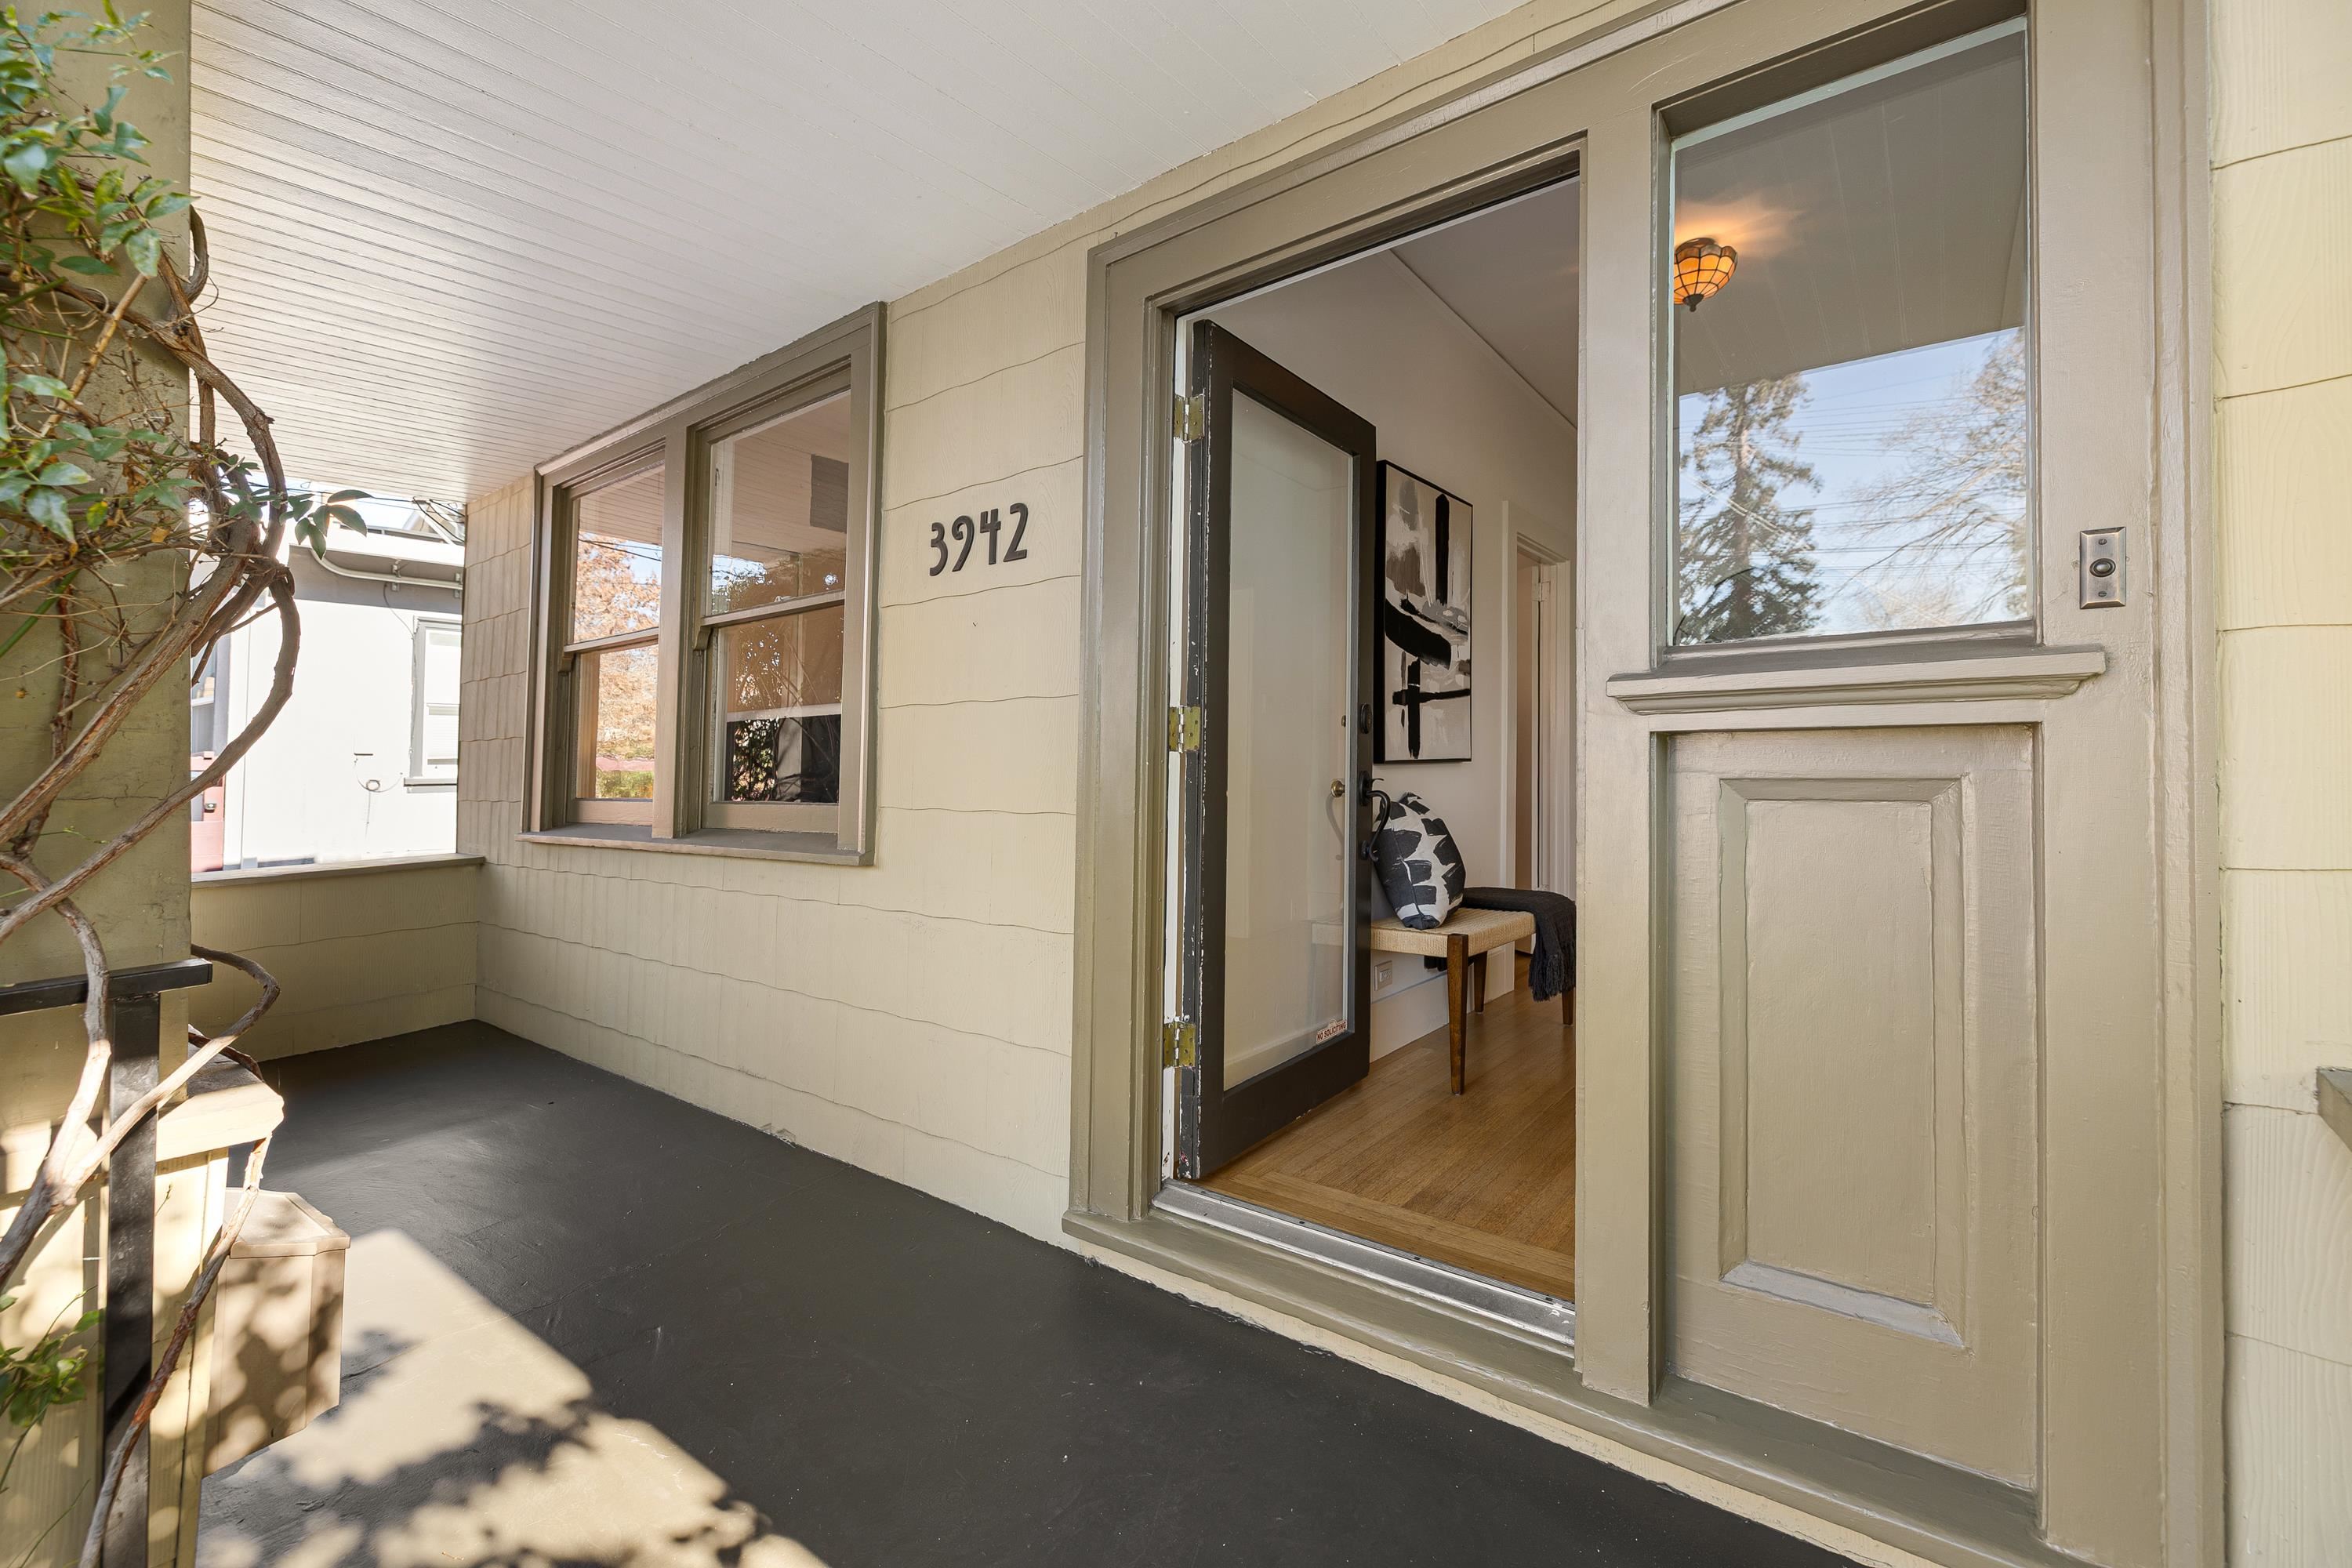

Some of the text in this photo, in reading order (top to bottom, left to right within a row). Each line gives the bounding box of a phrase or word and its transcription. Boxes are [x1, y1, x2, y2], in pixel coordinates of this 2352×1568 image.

[930, 503, 1028, 576] 3942
[1317, 1022, 1346, 1040] NO SOLICITING
